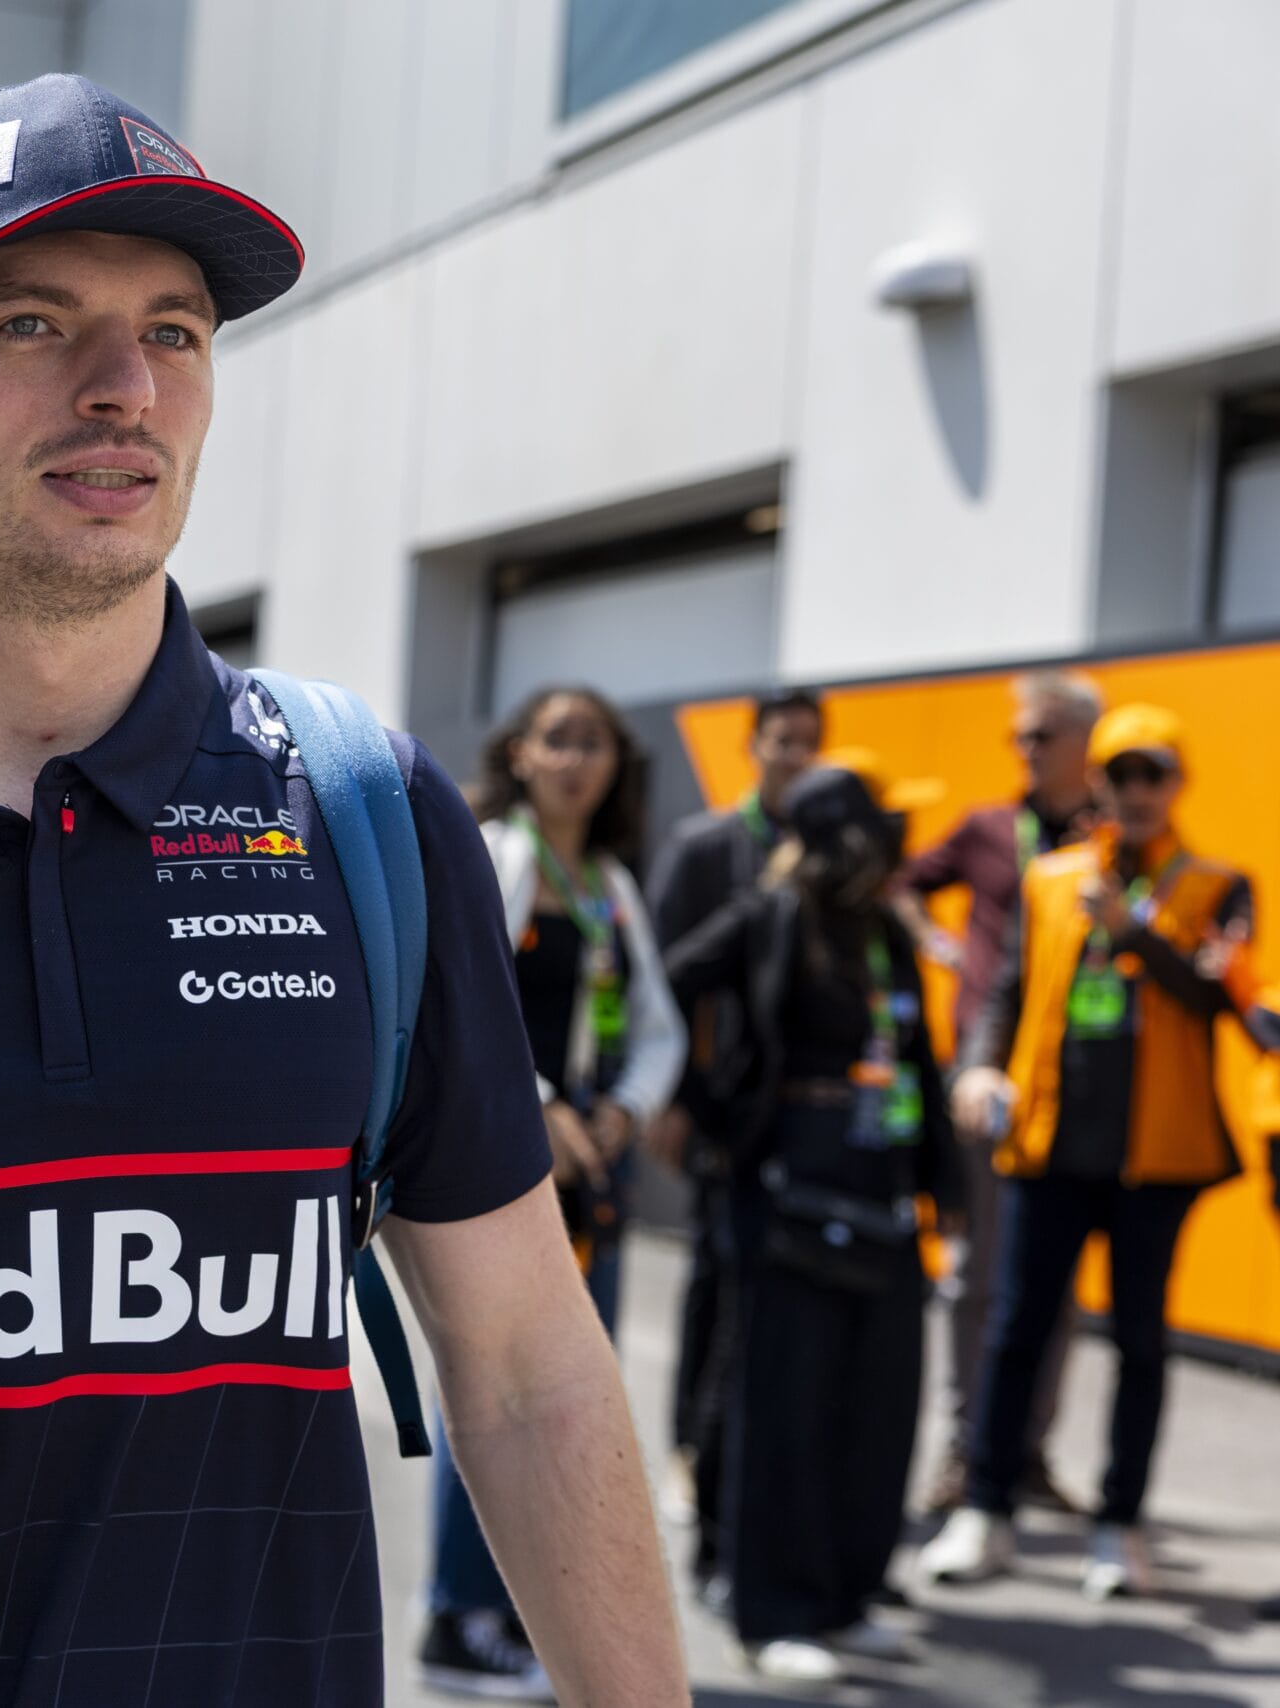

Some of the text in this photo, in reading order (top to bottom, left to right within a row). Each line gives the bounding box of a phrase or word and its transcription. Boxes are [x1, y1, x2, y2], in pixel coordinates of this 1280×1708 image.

[150, 832, 240, 857] Red Bull
[156, 866, 315, 883] RACING
[168, 914, 327, 939] HONDA
[217, 970, 336, 1000] Gate.io
[90, 1195, 344, 1345] Bull
